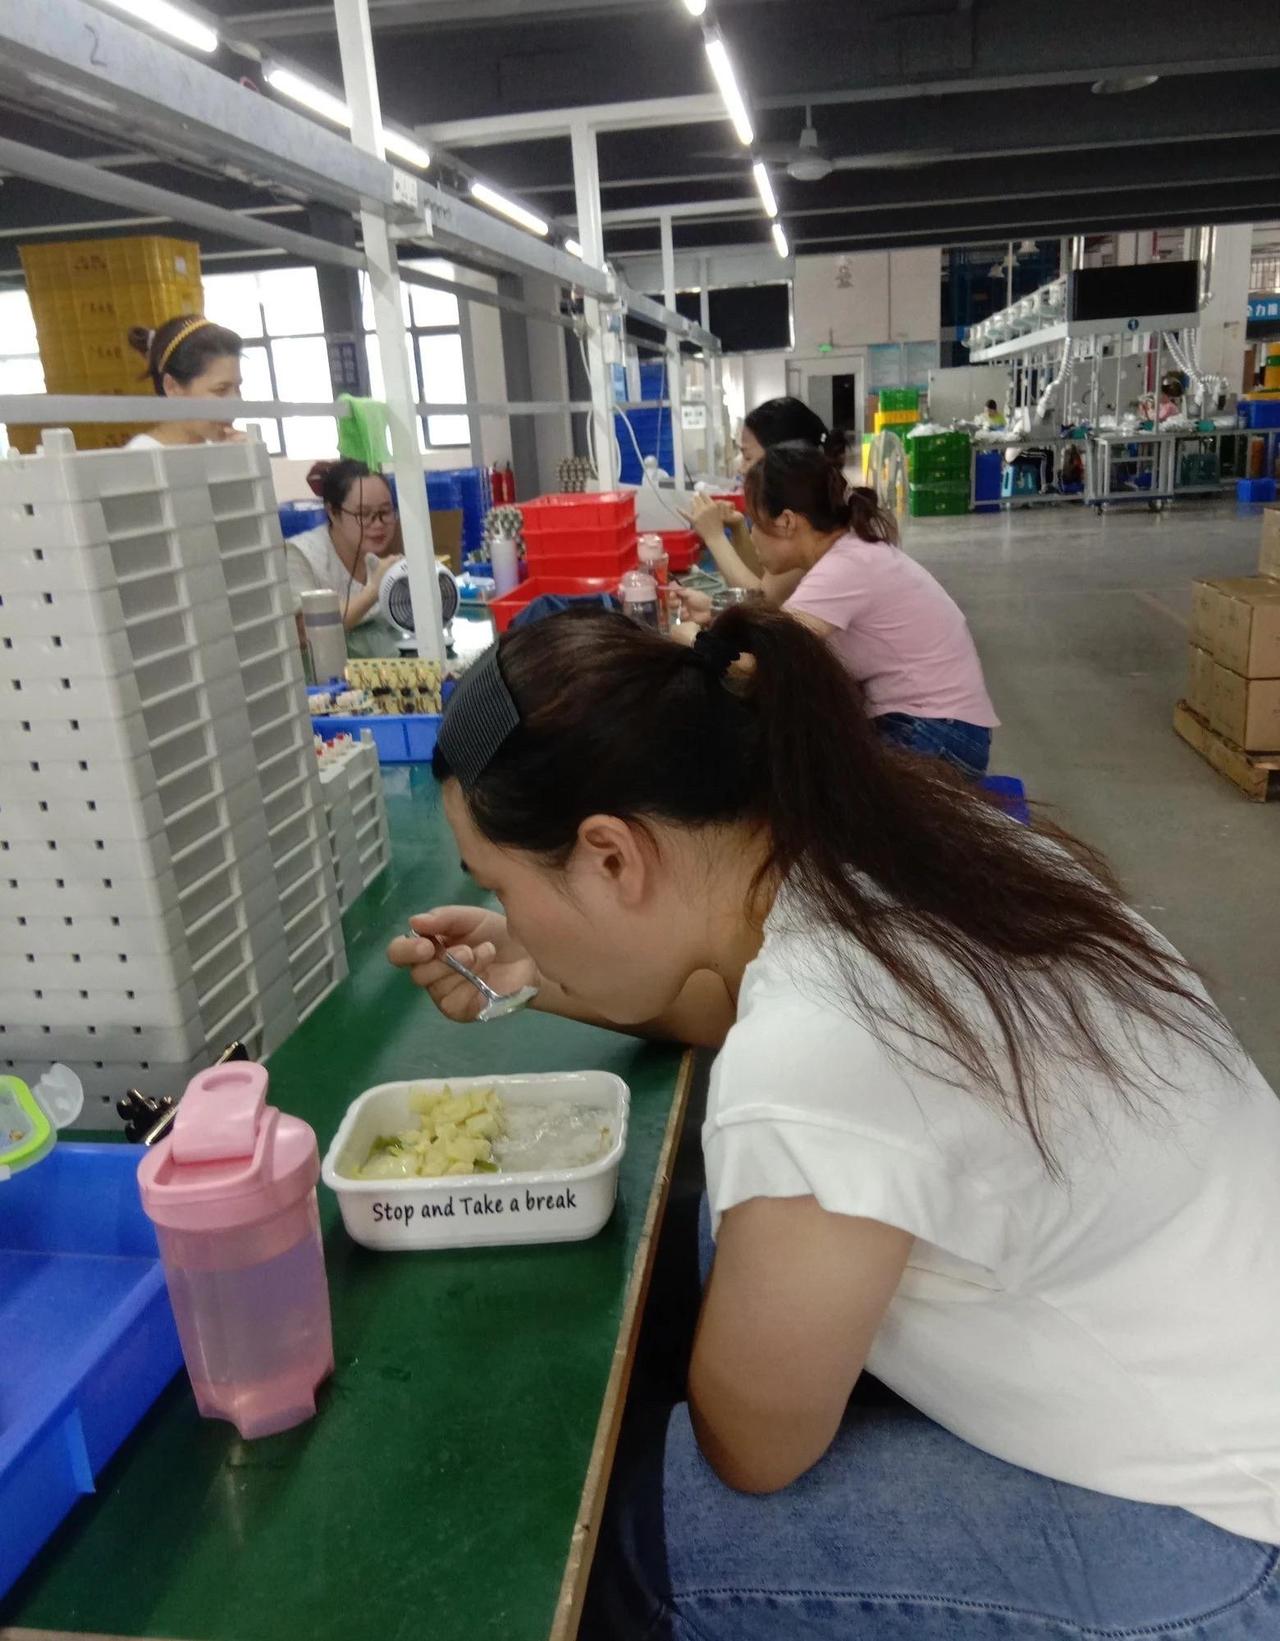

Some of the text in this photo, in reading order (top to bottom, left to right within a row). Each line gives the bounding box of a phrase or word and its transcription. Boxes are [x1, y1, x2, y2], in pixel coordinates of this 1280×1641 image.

[372, 1188, 577, 1226] Stop and Take a break
